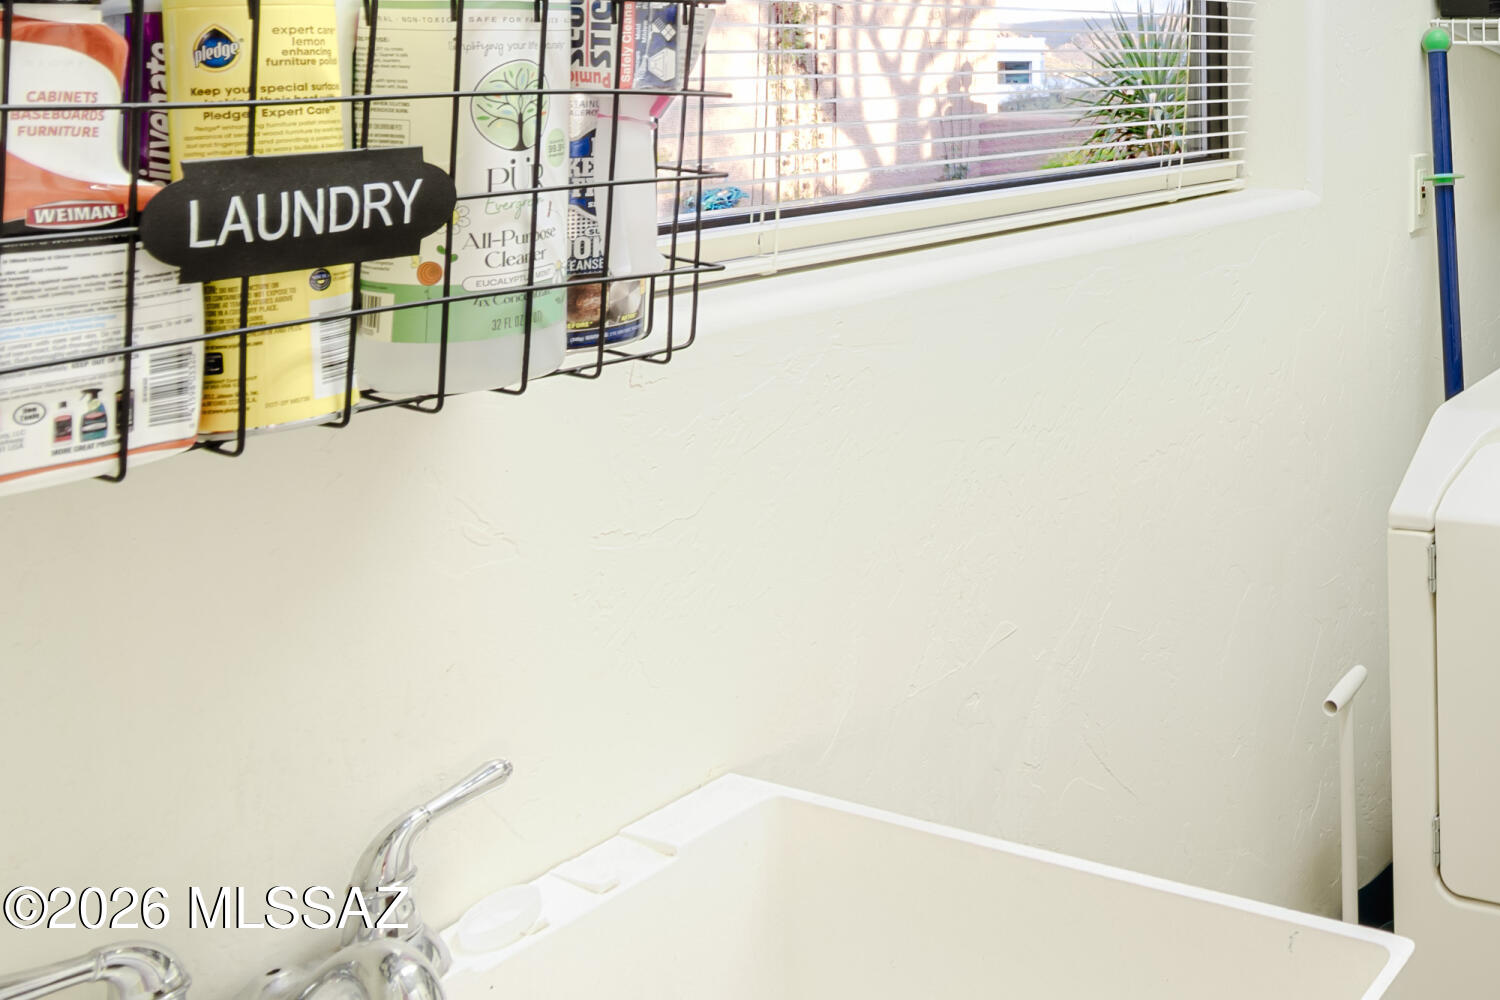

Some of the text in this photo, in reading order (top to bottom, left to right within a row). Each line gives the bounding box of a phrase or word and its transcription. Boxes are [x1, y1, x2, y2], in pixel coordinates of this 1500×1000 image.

[272, 26, 314, 37] expert
[292, 37, 325, 46] lemon
[194, 41, 240, 68] pledge
[281, 47, 332, 57] enhancing
[265, 57, 317, 67] furniture
[621, 47, 634, 83] Safely
[190, 87, 221, 96] Keep
[225, 87, 251, 96] you
[260, 83, 308, 93] special
[26, 90, 99, 104] CABINETS
[10, 109, 105, 121] BASEBOARDS
[261, 107, 303, 119] Expert
[17, 125, 100, 138] FURNITURE
[34, 205, 118, 224] WEIMAN
[189, 178, 424, 249] LAUNDRY
